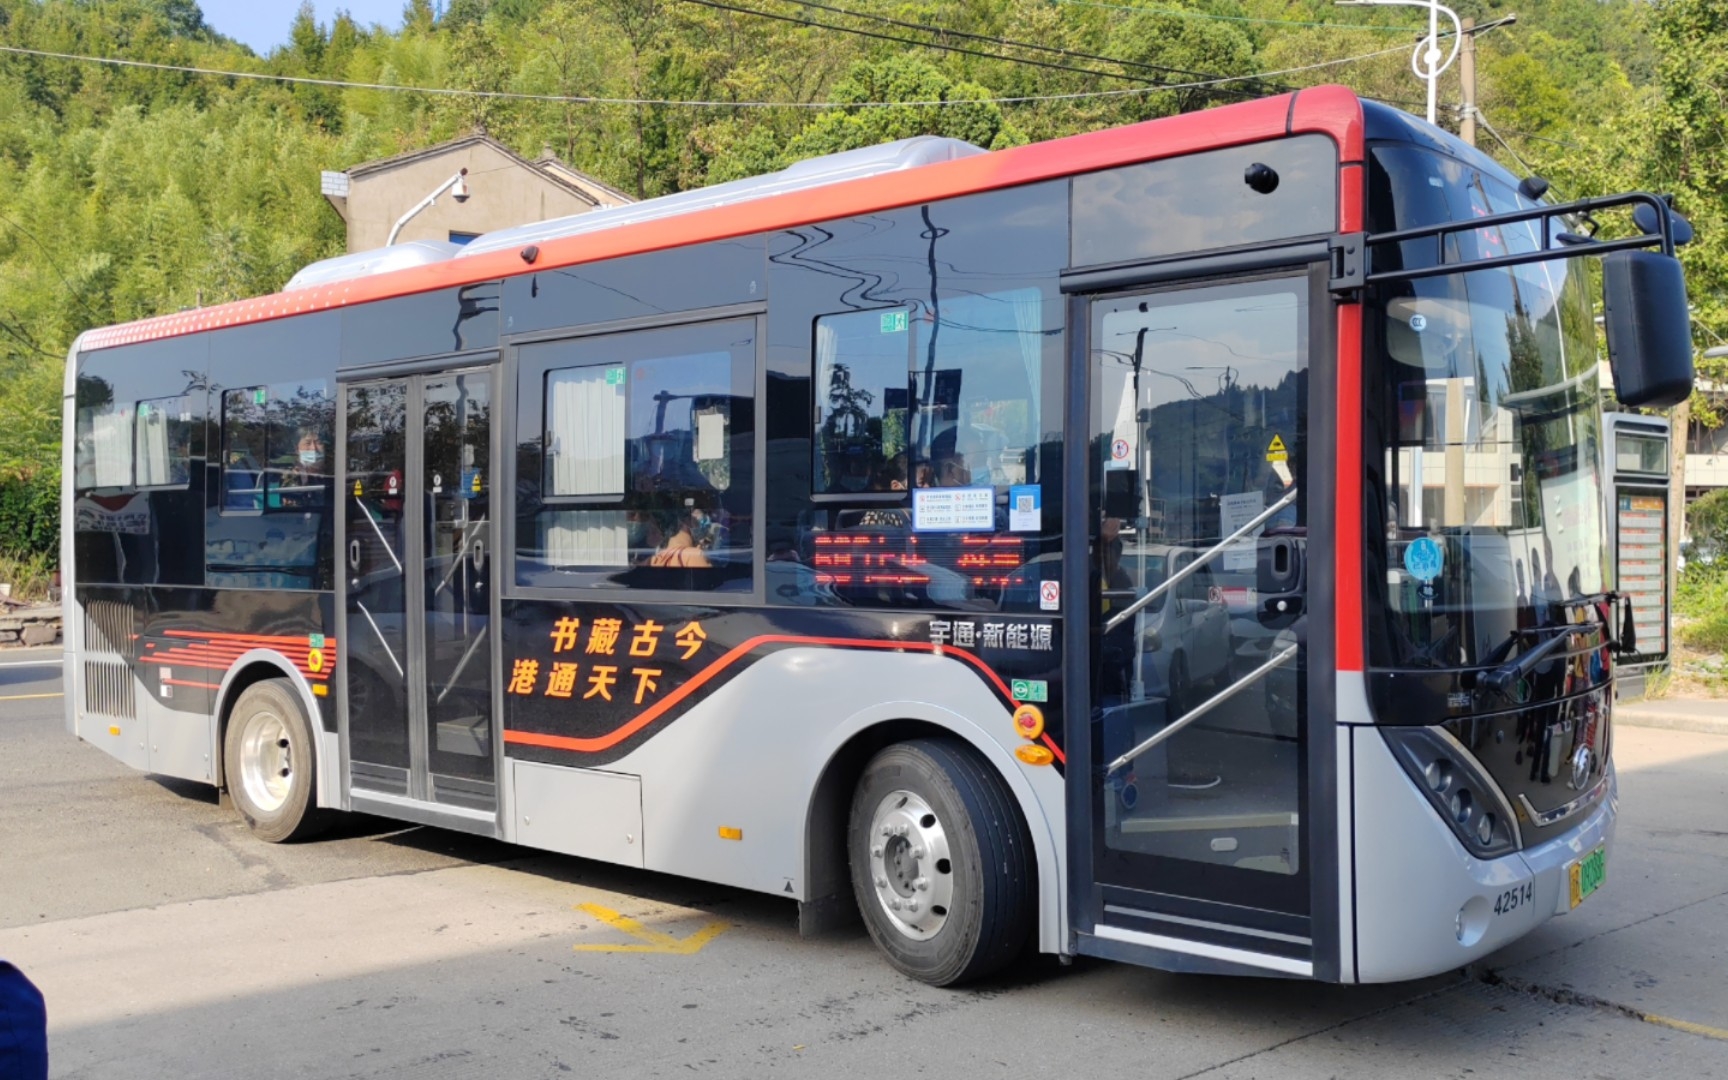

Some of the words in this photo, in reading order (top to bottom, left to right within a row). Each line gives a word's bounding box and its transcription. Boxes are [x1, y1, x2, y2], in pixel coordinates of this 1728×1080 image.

[550, 616, 707, 660] 书藏古今
[507, 658, 662, 704] 港通天下
[1494, 882, 1532, 916] 42514
